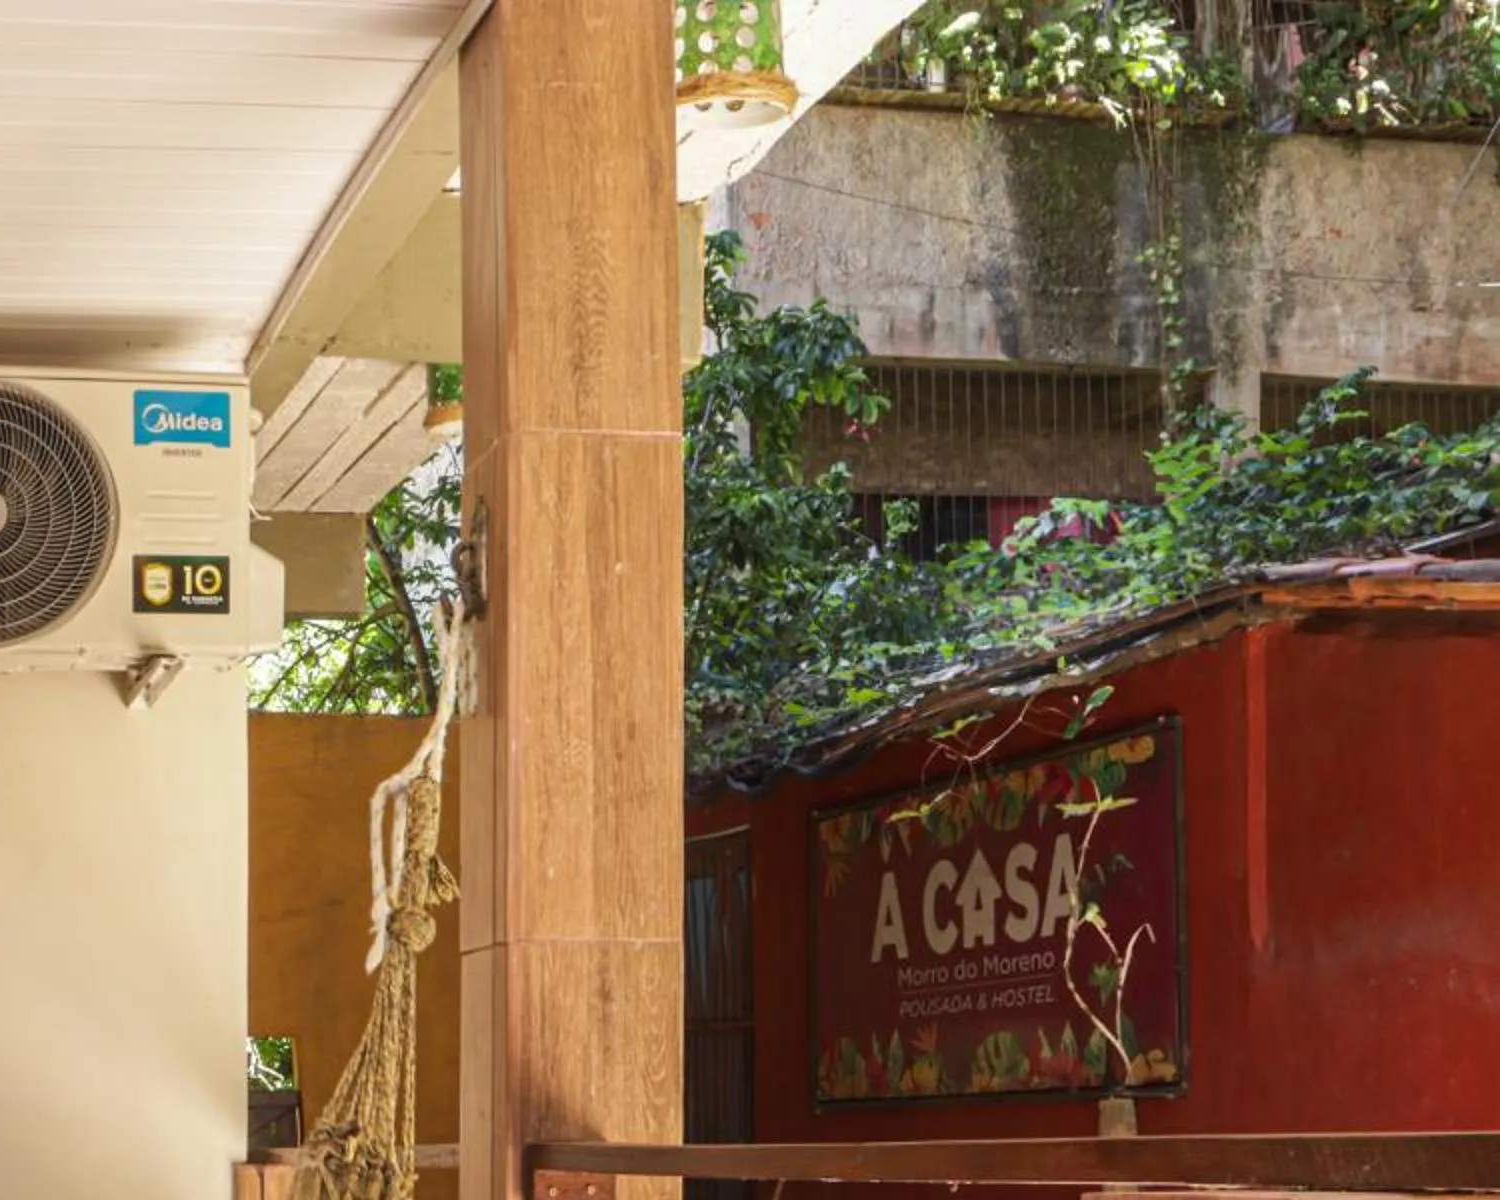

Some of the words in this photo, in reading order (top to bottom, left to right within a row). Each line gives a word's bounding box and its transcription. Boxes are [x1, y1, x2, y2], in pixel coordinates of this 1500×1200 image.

[143, 405, 224, 432] Midea
[183, 564, 222, 595] 10
[922, 832, 1079, 955] CASA
[898, 967, 949, 987] Morro
[953, 958, 978, 980] do
[983, 951, 1055, 977] Moreno
[900, 994, 973, 1018] POUSADA
[991, 984, 1055, 1009] HOSTEL
